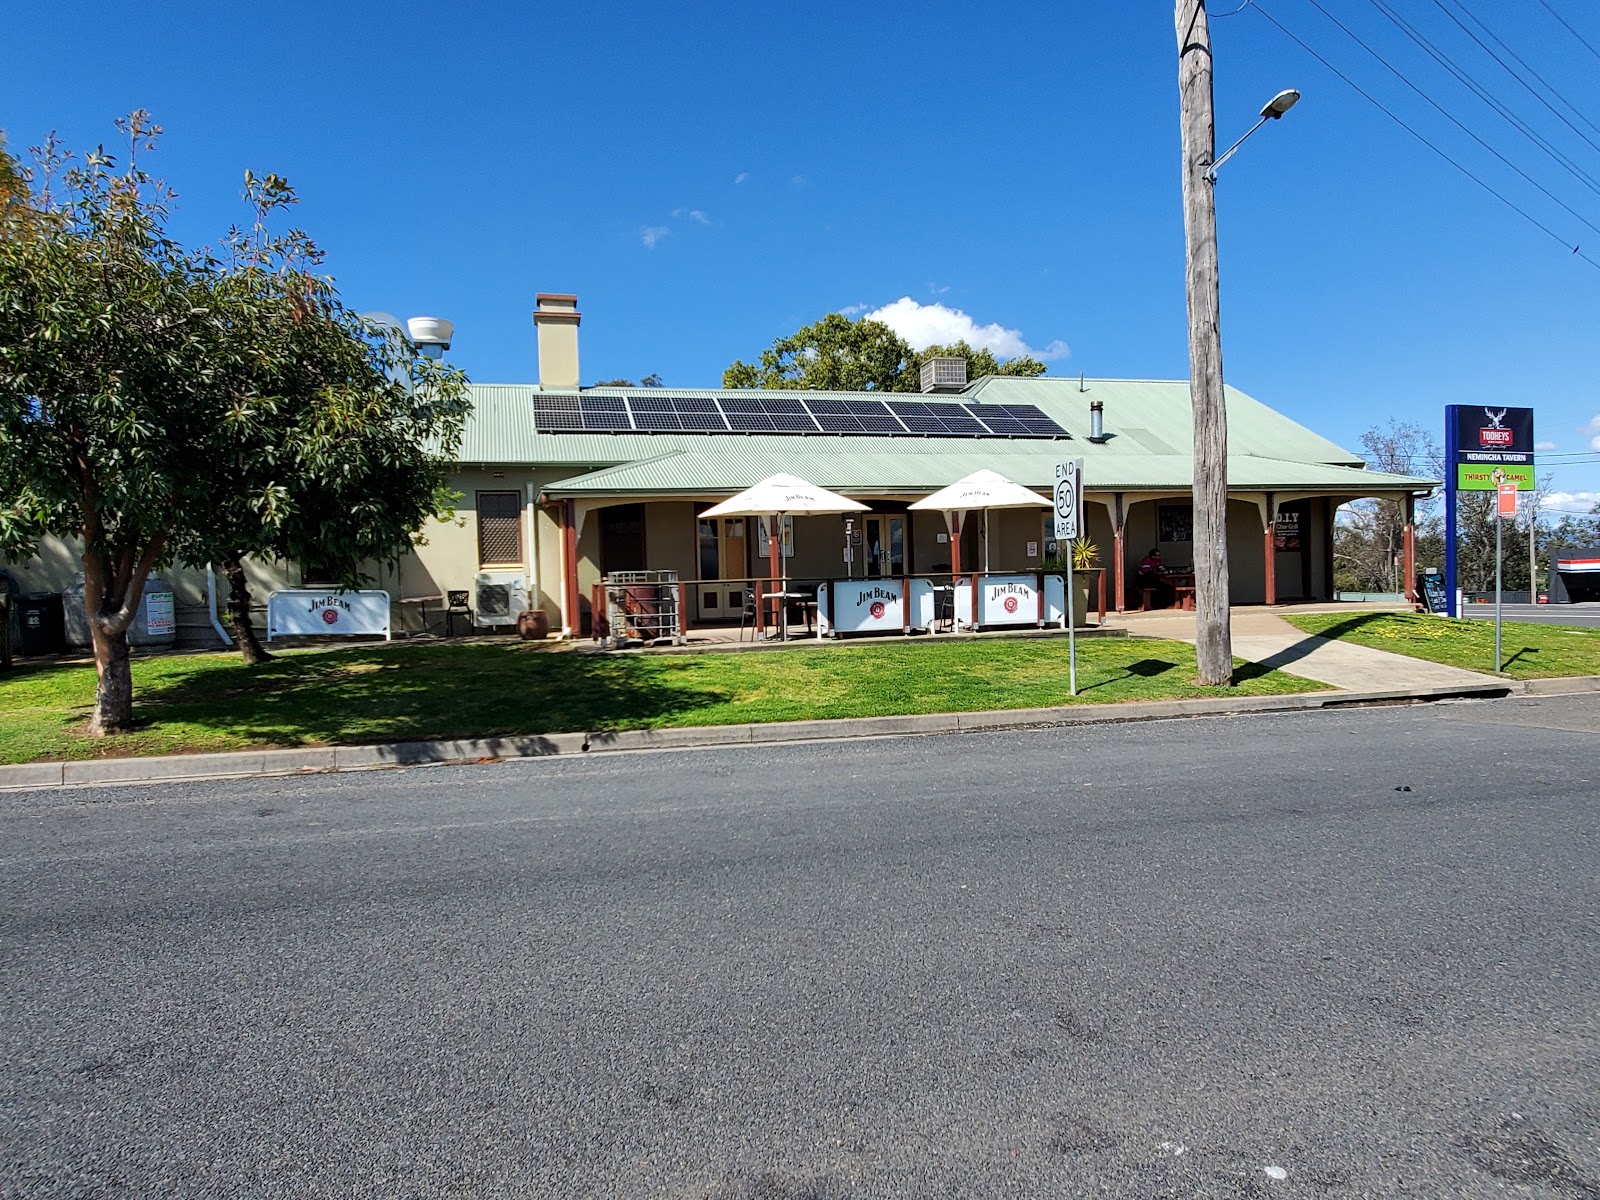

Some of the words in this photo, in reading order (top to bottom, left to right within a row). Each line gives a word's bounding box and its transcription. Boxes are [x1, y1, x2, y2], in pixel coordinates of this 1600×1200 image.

[1483, 432, 1509, 441] TOOHEYS
[1055, 462, 1075, 478] END
[1058, 489, 1072, 510] 50
[1056, 522, 1076, 537] AREA
[856, 590, 873, 607] JIM
[874, 587, 897, 604] BEAM
[991, 586, 1007, 601] JIM
[1007, 582, 1029, 600] BEAM
[308, 598, 326, 613] JIM
[327, 595, 351, 612] BEAM
